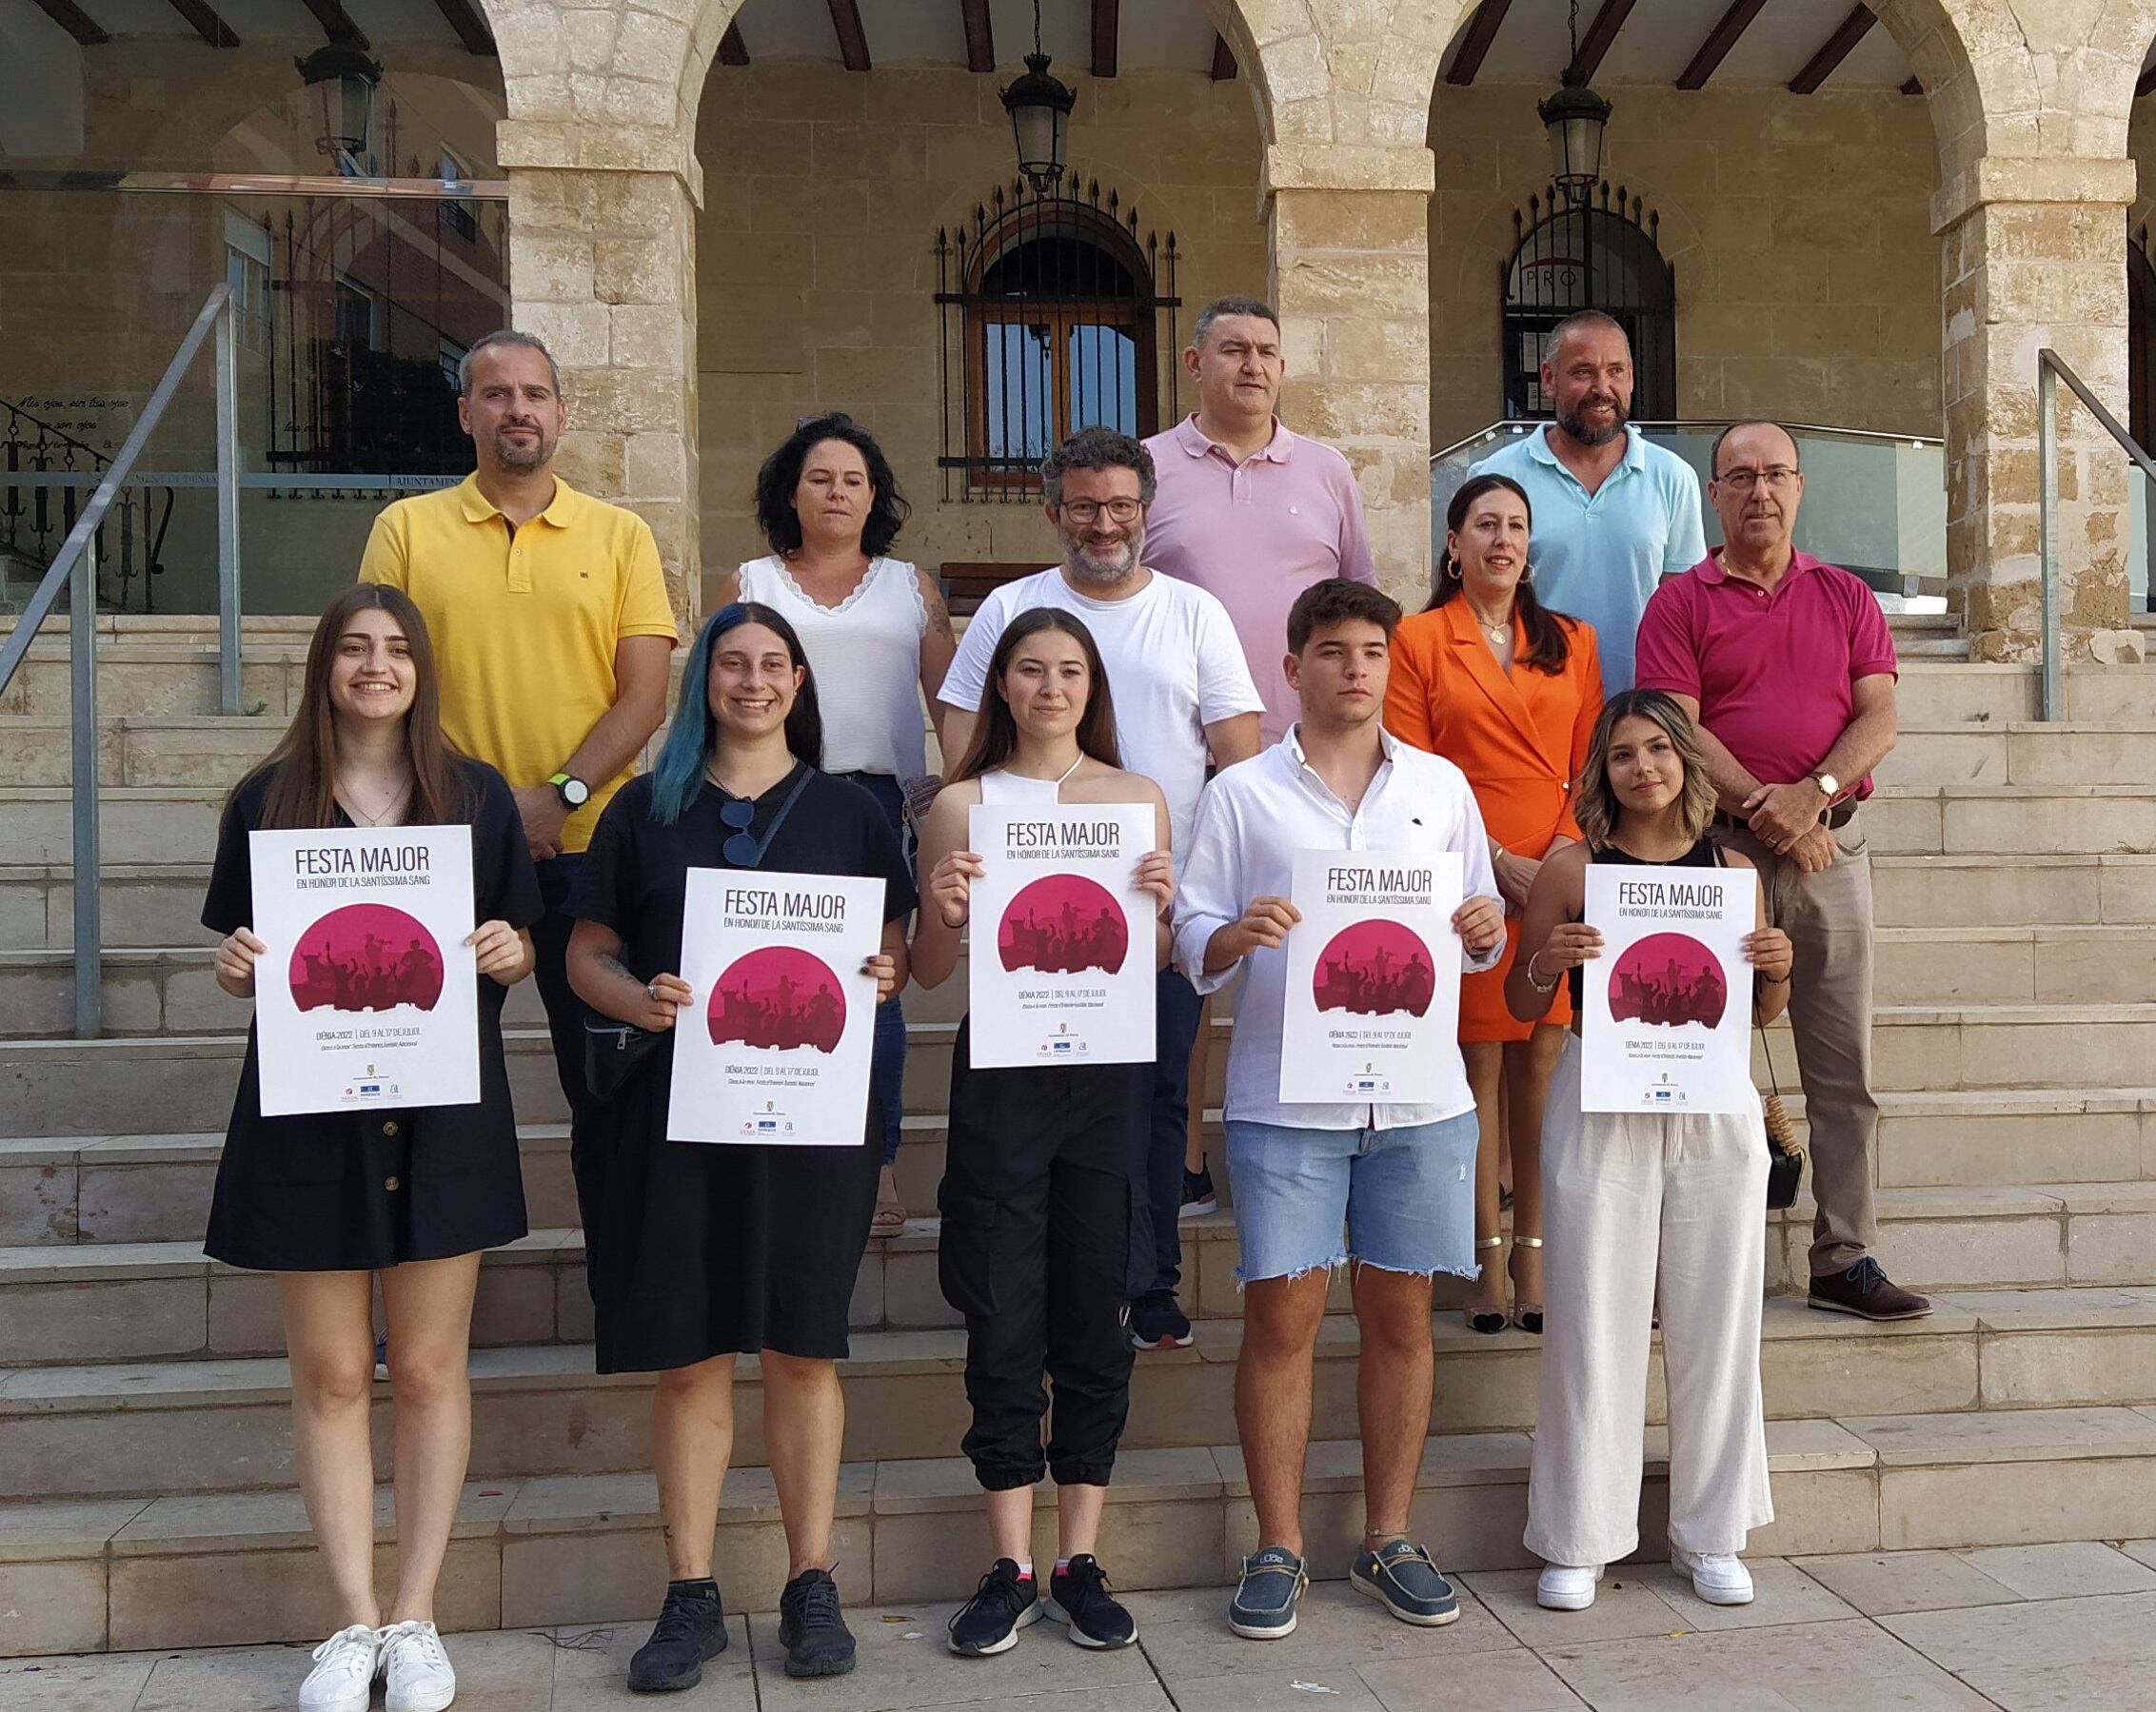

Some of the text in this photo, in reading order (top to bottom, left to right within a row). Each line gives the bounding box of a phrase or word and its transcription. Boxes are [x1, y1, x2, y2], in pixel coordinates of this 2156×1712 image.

[1006, 822, 1119, 846] FESTA MAJOR
[295, 846, 430, 875] FESTA MAJOR
[1006, 849, 1016, 859] EN
[1017, 849, 1041, 859] HONOR
[1041, 849, 1050, 859] DE
[1051, 849, 1060, 858] LA
[1100, 849, 1119, 858] SANG
[297, 878, 307, 889] EN
[308, 877, 337, 889] HONOR
[338, 876, 349, 888] DE
[349, 876, 360, 888] LA
[408, 875, 430, 886] SANG
[1328, 867, 1432, 892] FESTA MAJOR
[724, 889, 845, 919] FESTA MAJOR
[1326, 894, 1335, 904] EN
[1336, 894, 1359, 904] HONOR
[1359, 894, 1369, 904] DE
[1369, 895, 1377, 904] LA
[1414, 895, 1432, 905] SANG
[1619, 882, 1723, 908] FESTA MAJOR
[1619, 907, 1628, 917] EN
[1629, 908, 1651, 917] HONOR
[1651, 908, 1659, 918] DE
[1659, 909, 1668, 918] LA
[1705, 910, 1723, 920] SANG
[723, 917, 734, 928] EN
[735, 917, 762, 930] HONOR
[762, 919, 771, 931] DE
[771, 919, 781, 931] LA
[824, 922, 844, 934] SANG
